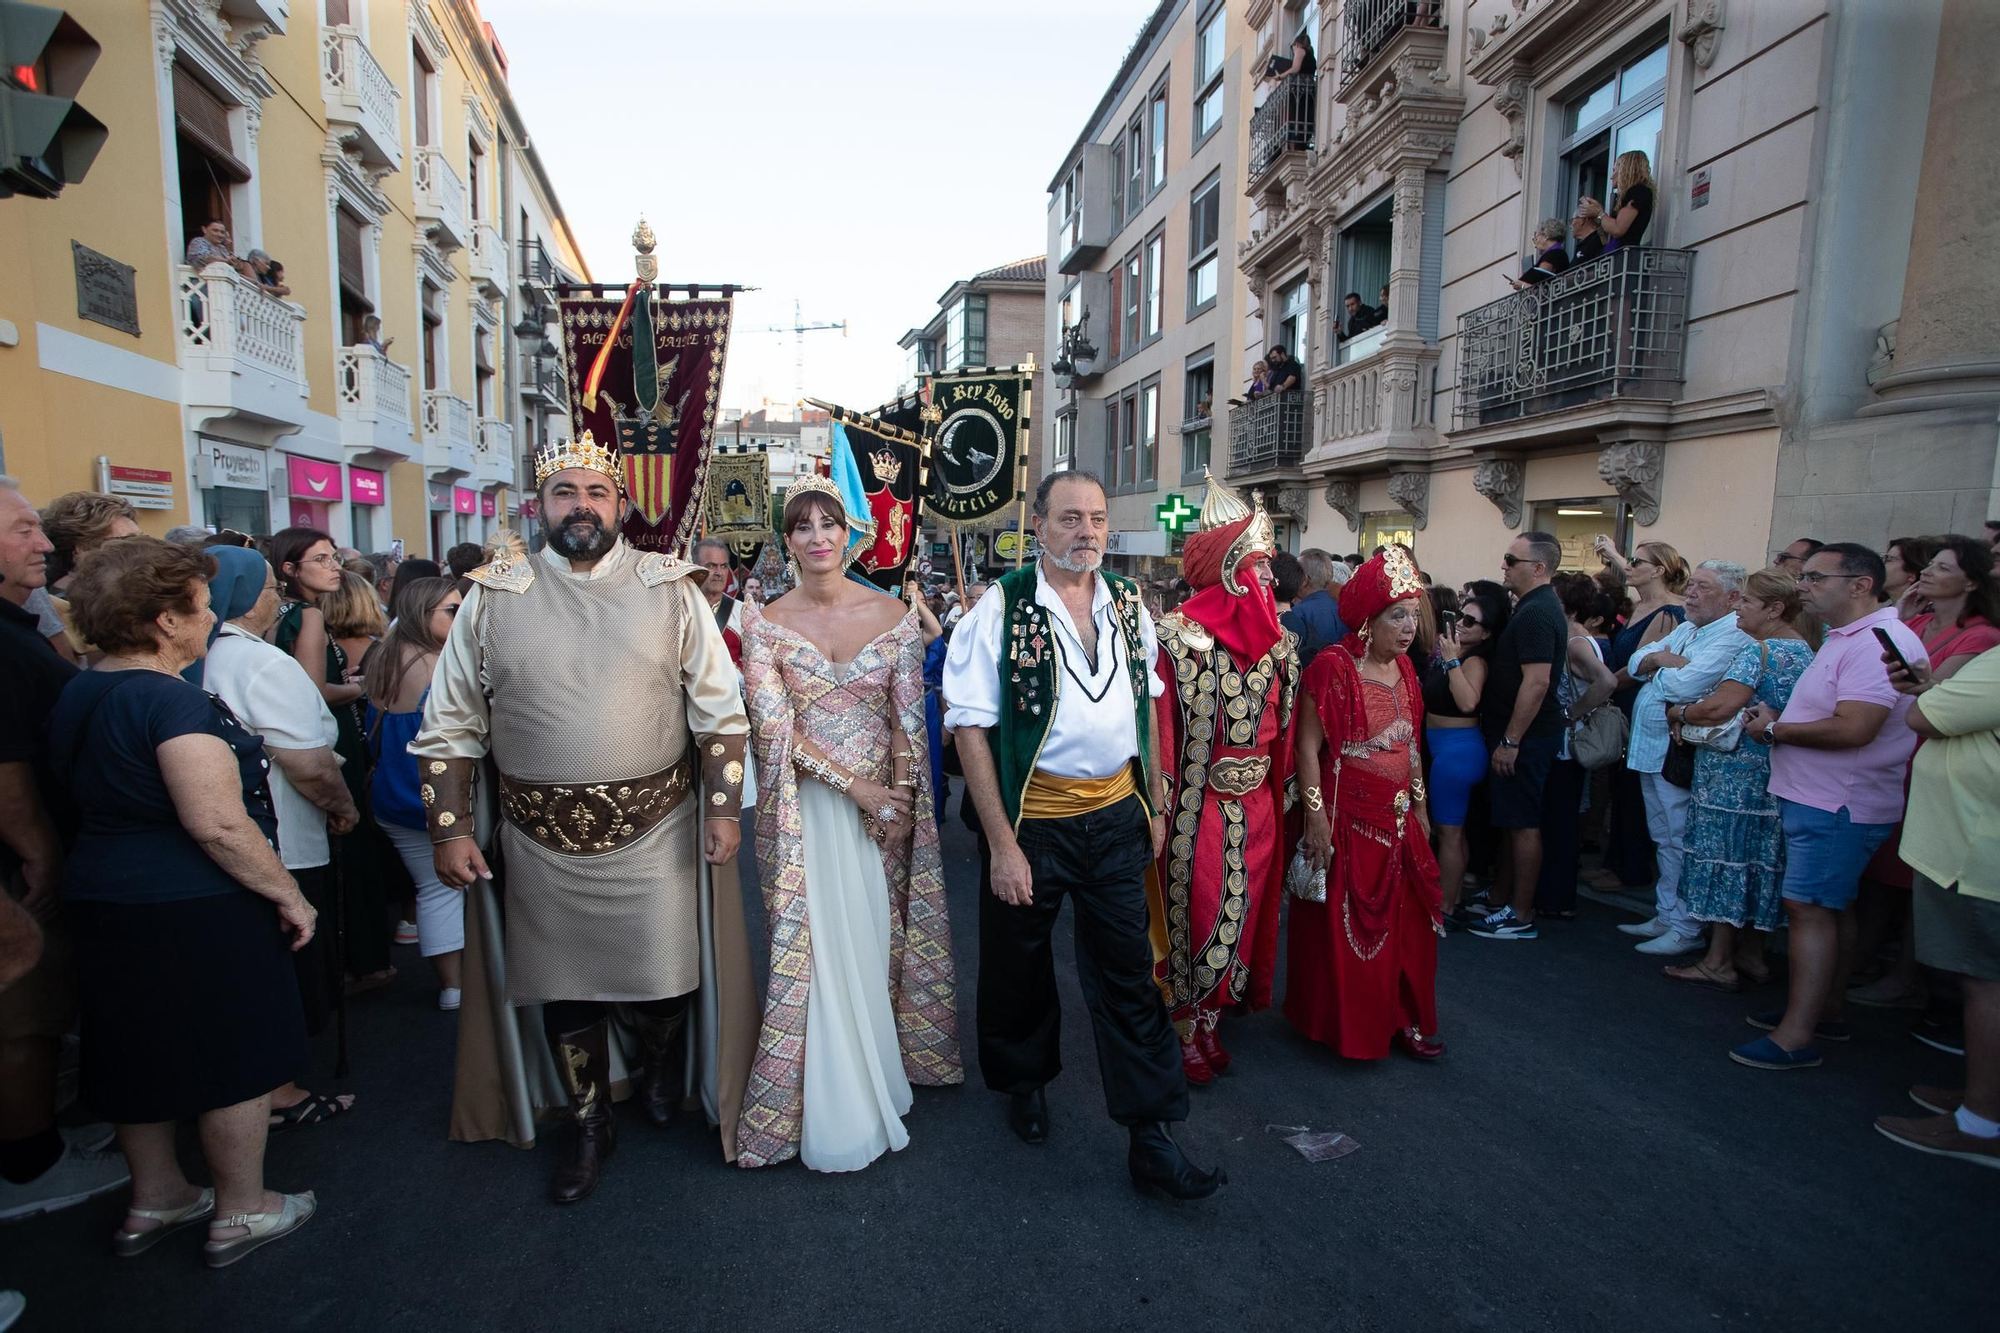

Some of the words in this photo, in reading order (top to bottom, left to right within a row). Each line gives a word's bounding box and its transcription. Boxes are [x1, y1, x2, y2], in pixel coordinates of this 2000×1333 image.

[953, 384, 983, 403] Rey
[983, 383, 1014, 420] Lobo
[213, 447, 260, 473] Proyecto
